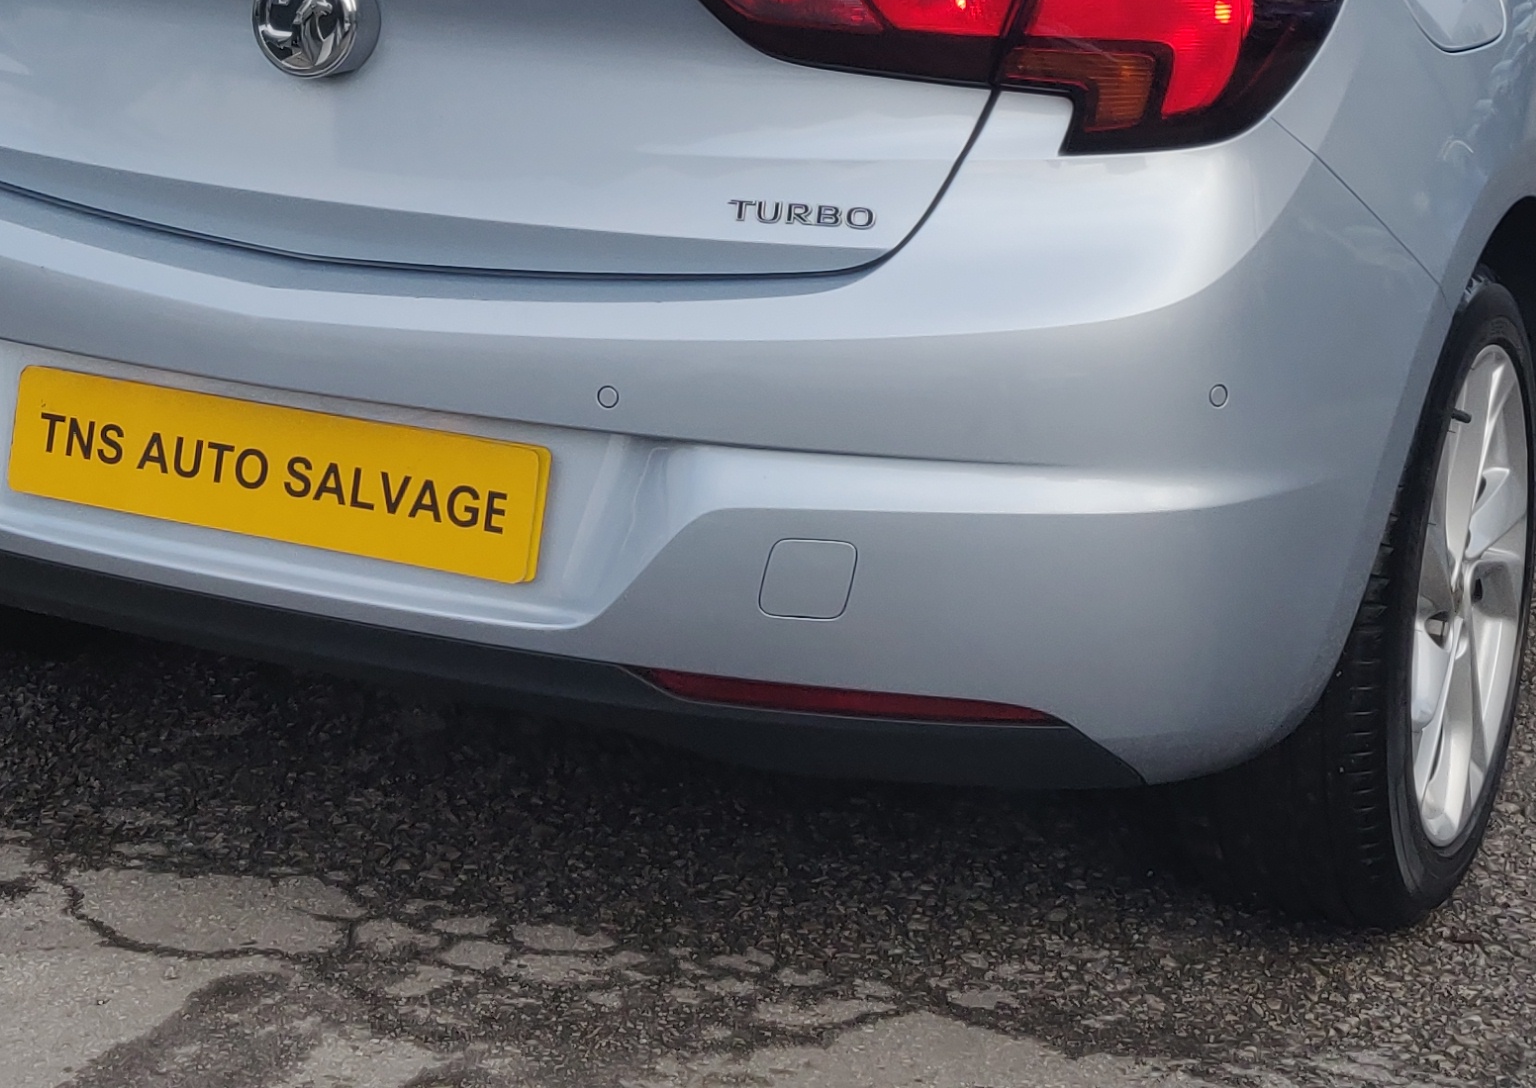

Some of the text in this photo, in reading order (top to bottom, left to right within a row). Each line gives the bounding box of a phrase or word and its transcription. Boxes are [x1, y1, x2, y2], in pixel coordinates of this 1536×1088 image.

[727, 199, 877, 230] TURBO
[40, 412, 509, 535] TNS AUTO SALVAGE
